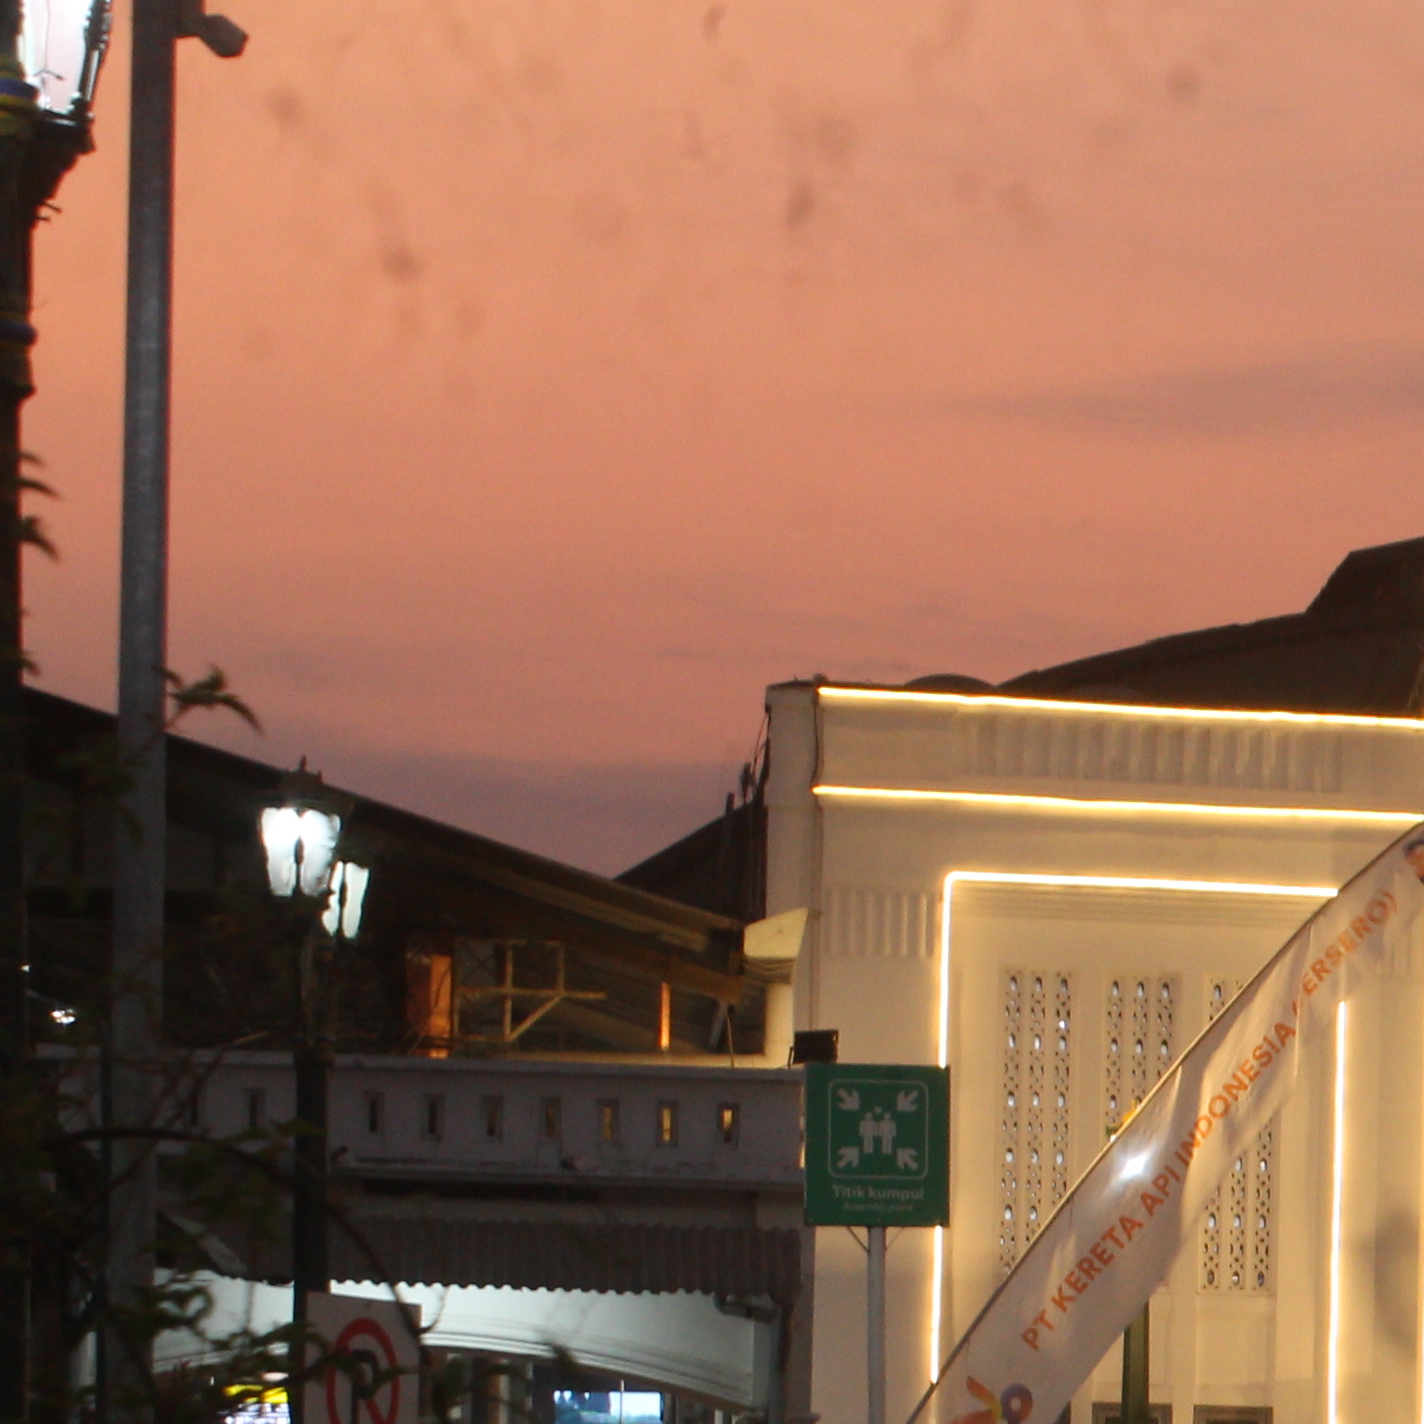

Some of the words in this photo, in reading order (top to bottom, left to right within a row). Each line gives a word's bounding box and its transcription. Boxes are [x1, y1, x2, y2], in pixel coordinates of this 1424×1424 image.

[1021, 1308, 1056, 1350] PT
[1051, 1213, 1144, 1313] KERETA
[1139, 1162, 1181, 1217] API
[1173, 1020, 1297, 1168] INDONESIA
[1290, 891, 1399, 1017] (ERSERO)
